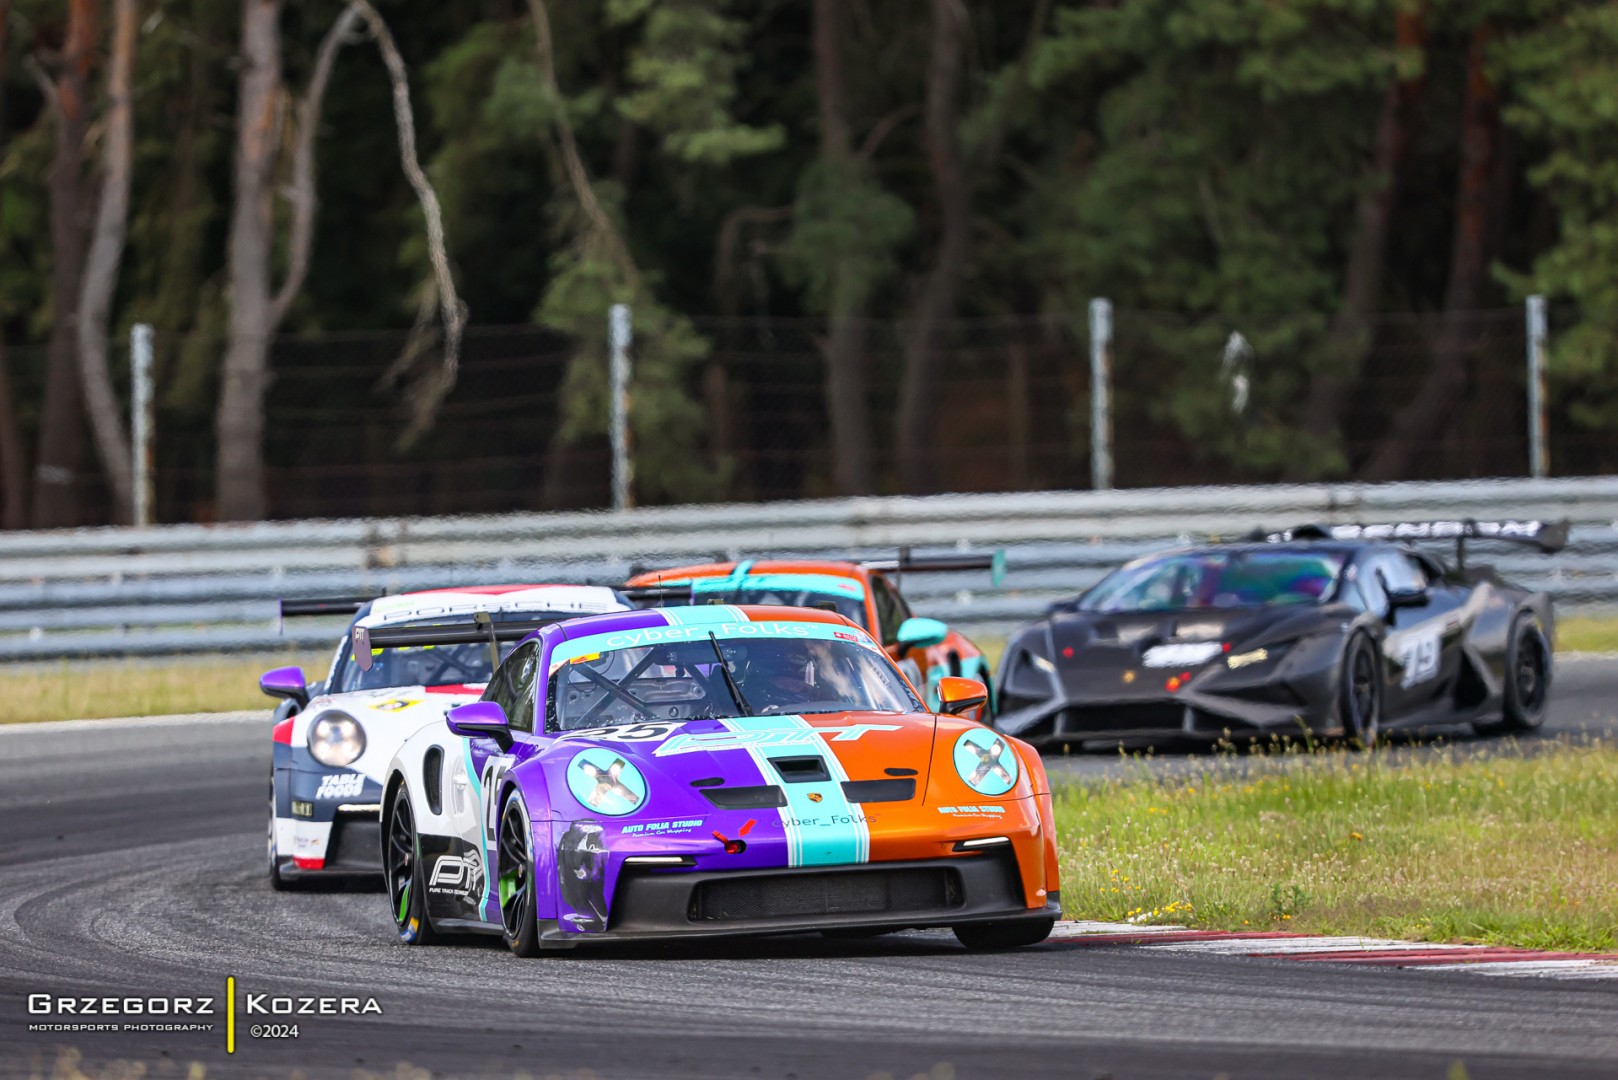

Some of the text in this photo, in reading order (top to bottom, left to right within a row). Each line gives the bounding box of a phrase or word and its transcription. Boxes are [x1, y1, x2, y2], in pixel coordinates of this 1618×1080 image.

[316, 784, 363, 800] FOODS
[621, 819, 703, 834] AUTO FOLIA STUDIO
